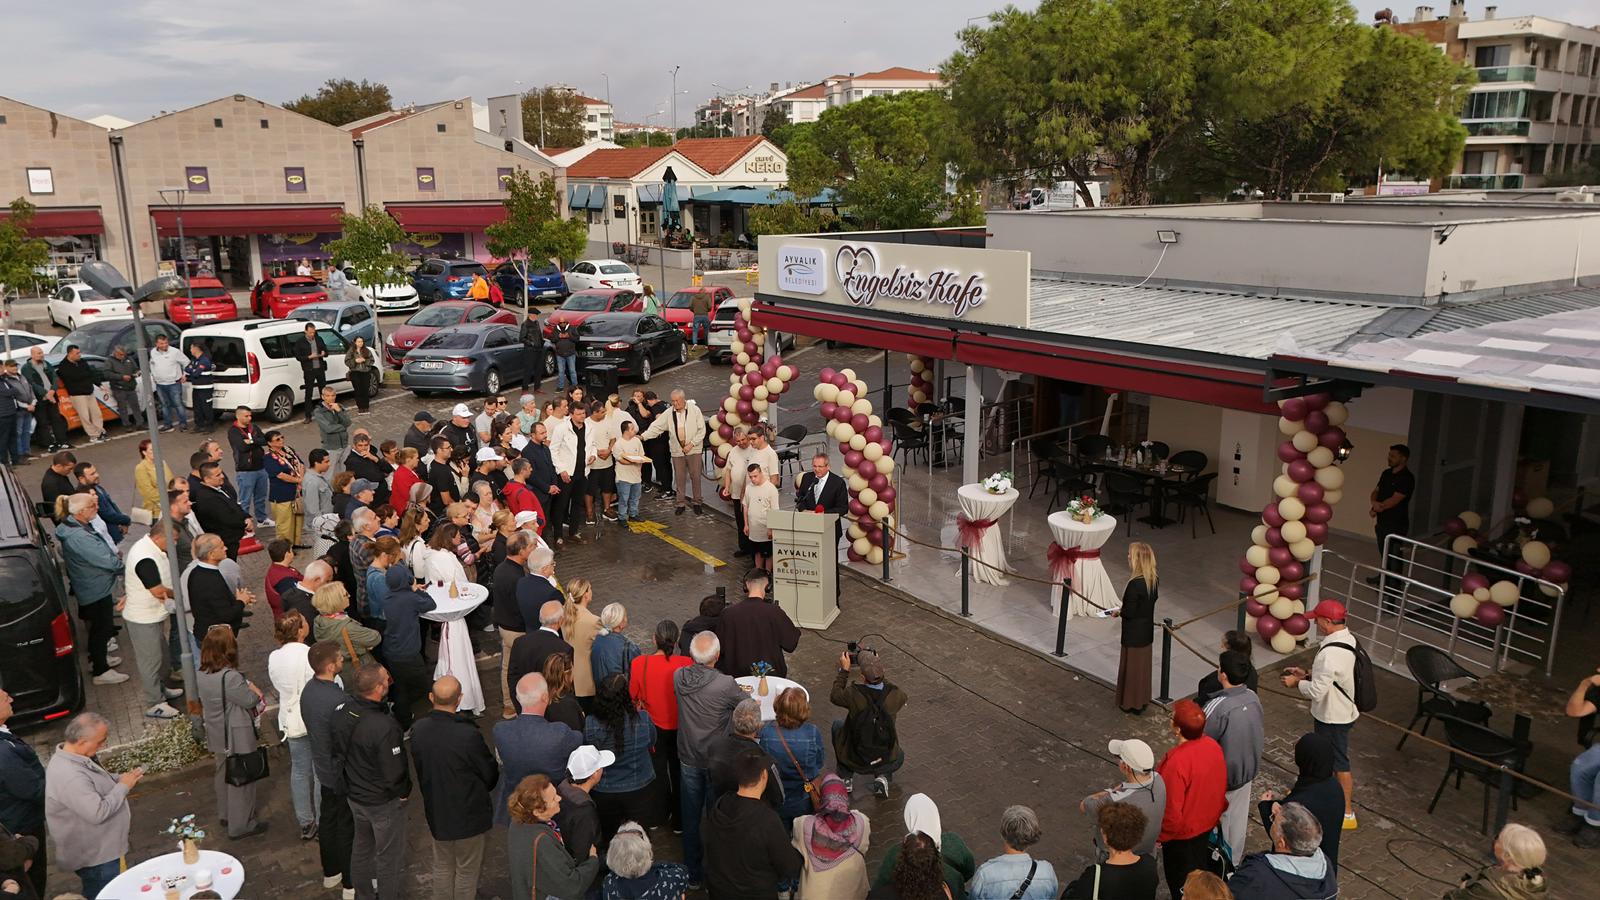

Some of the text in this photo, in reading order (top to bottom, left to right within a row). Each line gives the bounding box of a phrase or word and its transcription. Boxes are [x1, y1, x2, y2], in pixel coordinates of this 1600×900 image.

[745, 162, 783, 173] NERO
[416, 232, 439, 241] gratis
[784, 255, 817, 265] AYVALIK
[928, 271, 983, 316] Kafe
[777, 549, 818, 559] AYVALIK
